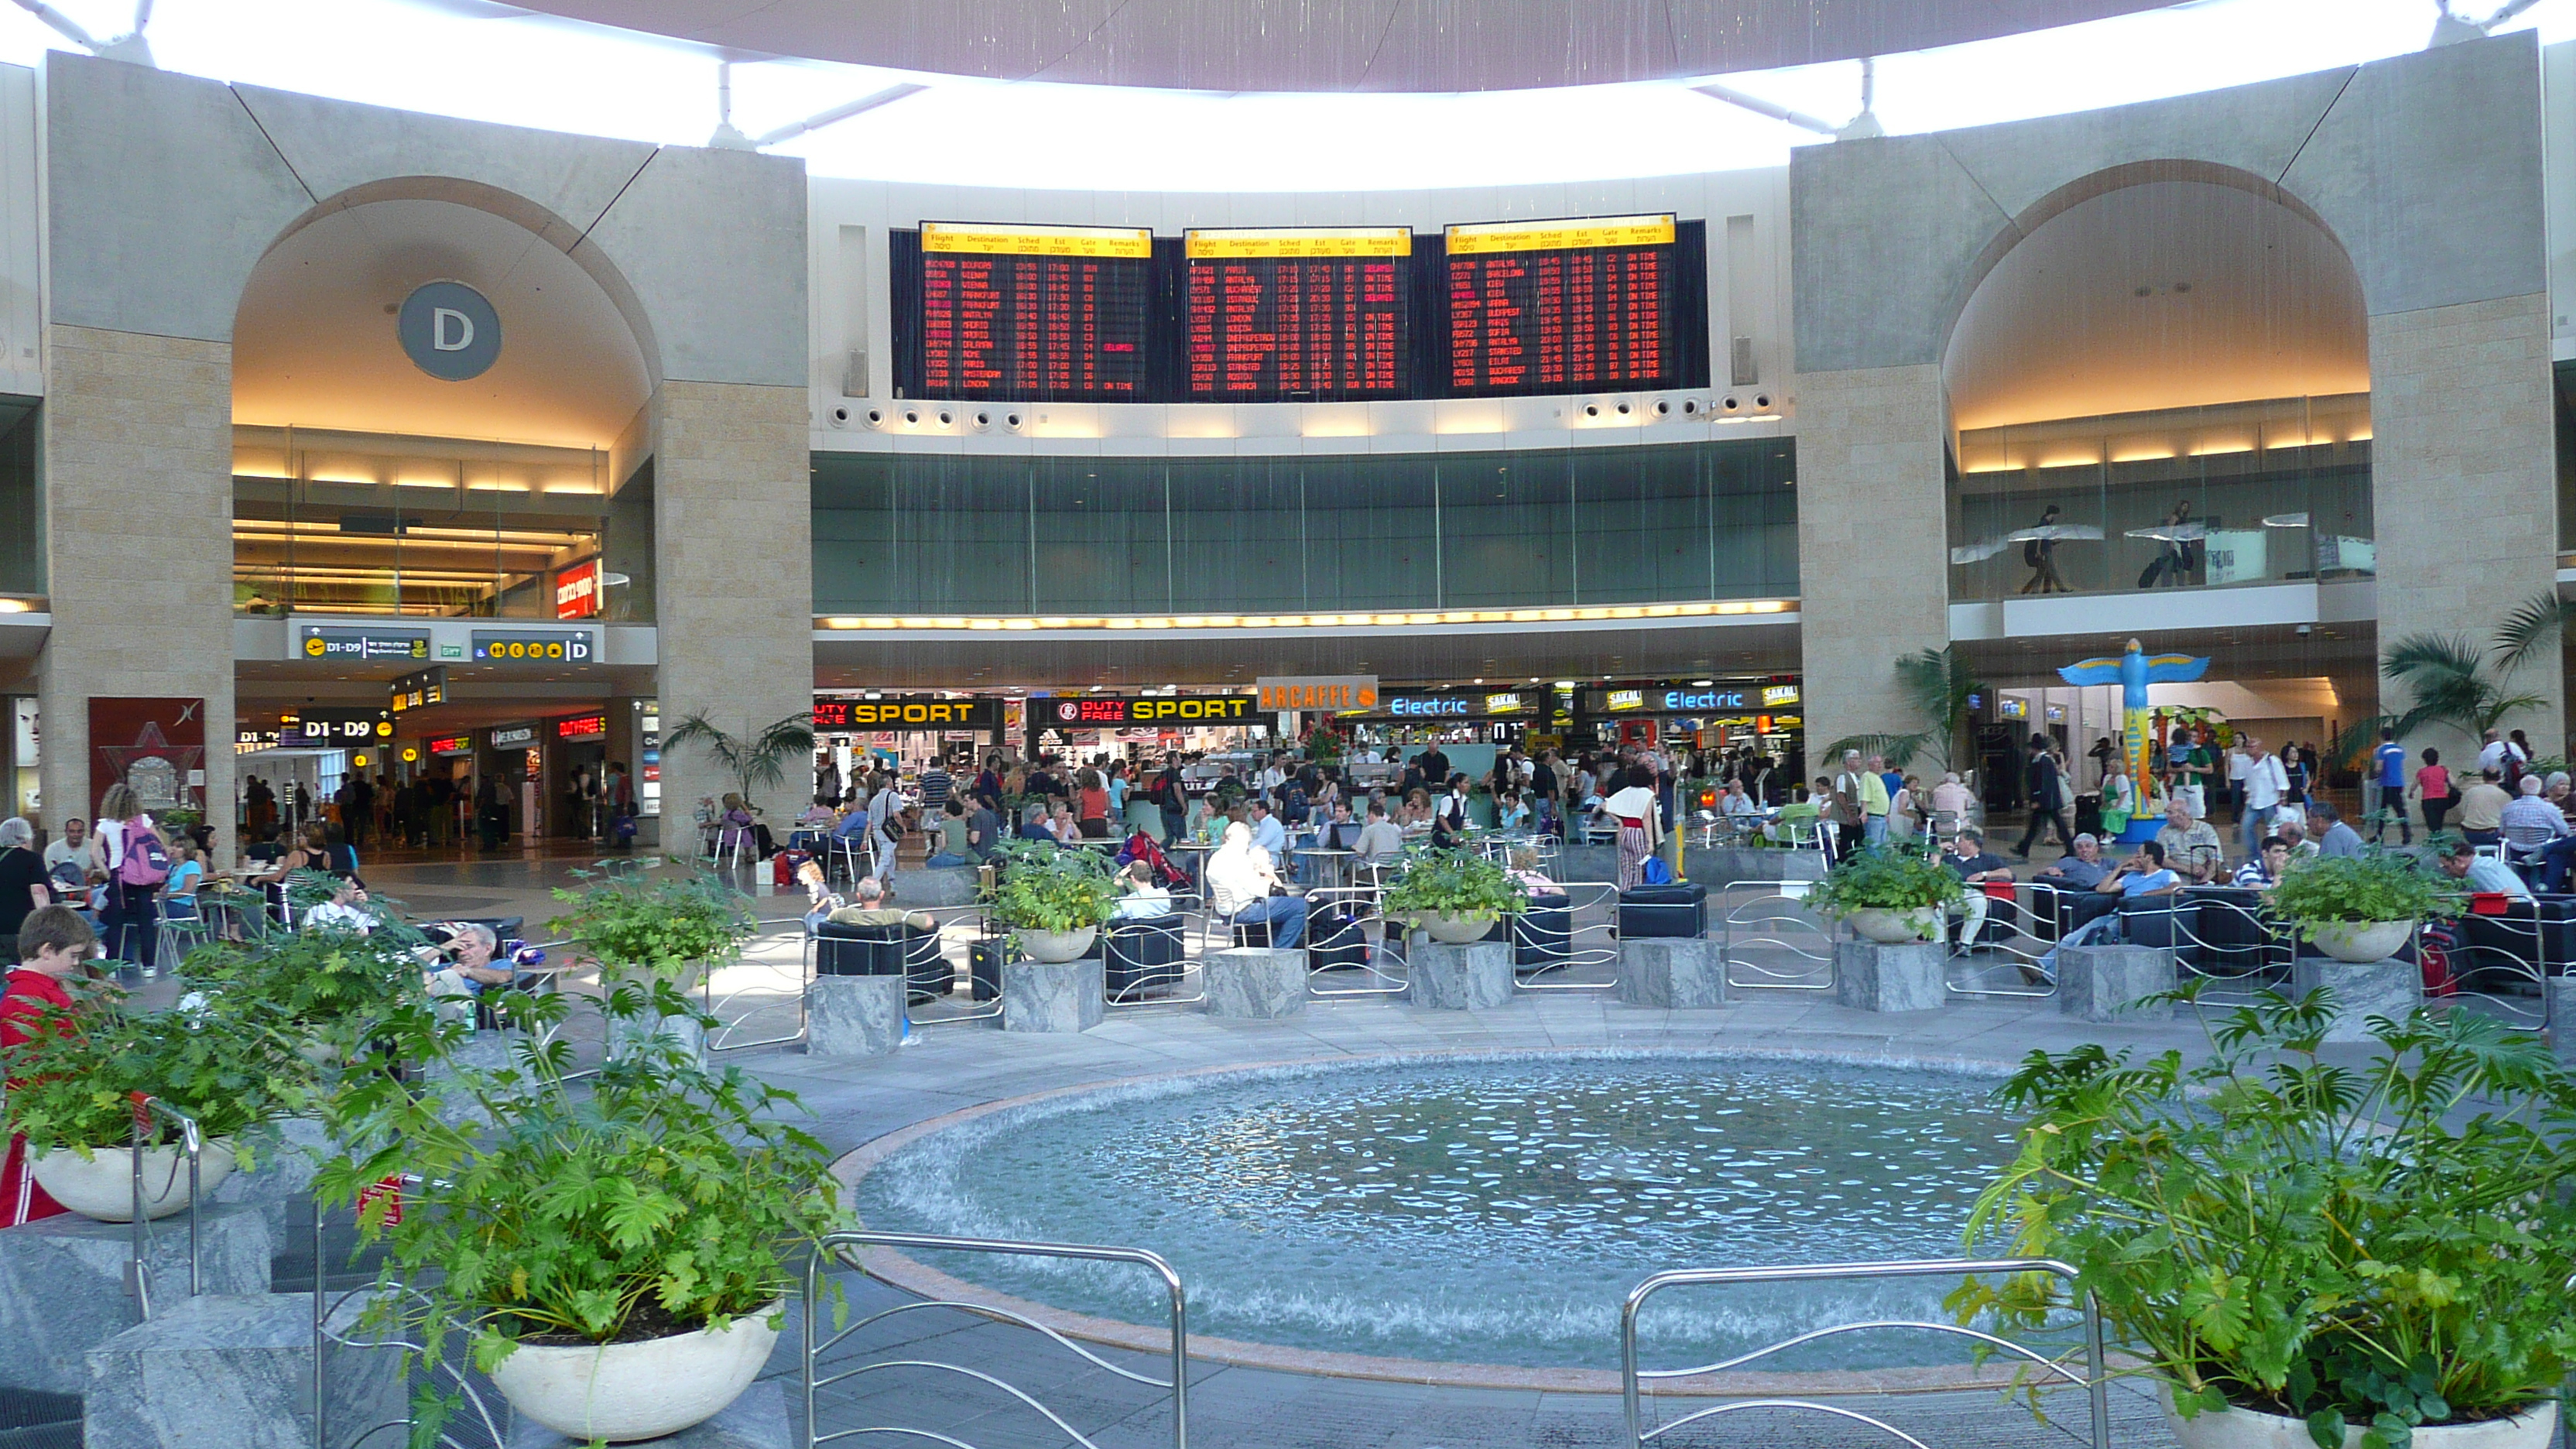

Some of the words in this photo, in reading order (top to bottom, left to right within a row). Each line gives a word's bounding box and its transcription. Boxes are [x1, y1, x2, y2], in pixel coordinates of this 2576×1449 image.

[968, 235, 1008, 244] Destination
[1628, 252, 1637, 262] ON
[1641, 252, 1656, 261] TIME
[962, 270, 988, 279] VIENNA
[1365, 274, 1375, 283] ON
[1377, 273, 1393, 283] TIME
[962, 280, 988, 289] VIENNA
[1365, 283, 1375, 293] ON
[1378, 283, 1393, 293] TIME
[1629, 291, 1639, 300] ON
[1641, 290, 1657, 300] TIME
[1227, 313, 1252, 323] LONDON
[1365, 313, 1375, 321] ON
[1379, 312, 1393, 321] TIME
[434, 307, 474, 351] D
[1488, 327, 1509, 337] SOFIA
[1629, 331, 1639, 340] ON
[1642, 330, 1658, 339] TIME
[963, 349, 980, 358] ROME
[1630, 350, 1640, 359] ON
[1642, 349, 1659, 358] TIME
[964, 359, 985, 368] PARIS
[1630, 370, 1640, 379] ON
[1643, 369, 1659, 379] TIME
[964, 379, 989, 389] LONDON
[1105, 382, 1114, 390] ON
[1117, 382, 1132, 391] TIME
[1366, 380, 1376, 389] ON
[1379, 380, 1394, 389] TIME
[327, 642, 361, 653] D1-D9
[573, 643, 587, 659] D
[1261, 685, 1351, 708] ARCAFFE
[1610, 690, 1641, 703] SAKAL
[1765, 686, 1797, 699] SAKAL
[1488, 694, 1519, 706] SAKAL
[1666, 690, 1742, 709] Electric
[814, 704, 847, 714] UTY
[1081, 701, 1125, 710] DUTY
[1132, 700, 1248, 719] SPORT
[1392, 697, 1468, 714] Electric
[855, 704, 974, 723] SPORT
[1081, 711, 1124, 721] FREE
[306, 722, 330, 736] D1
[344, 722, 370, 736] D9
[241, 731, 258, 742] D1
